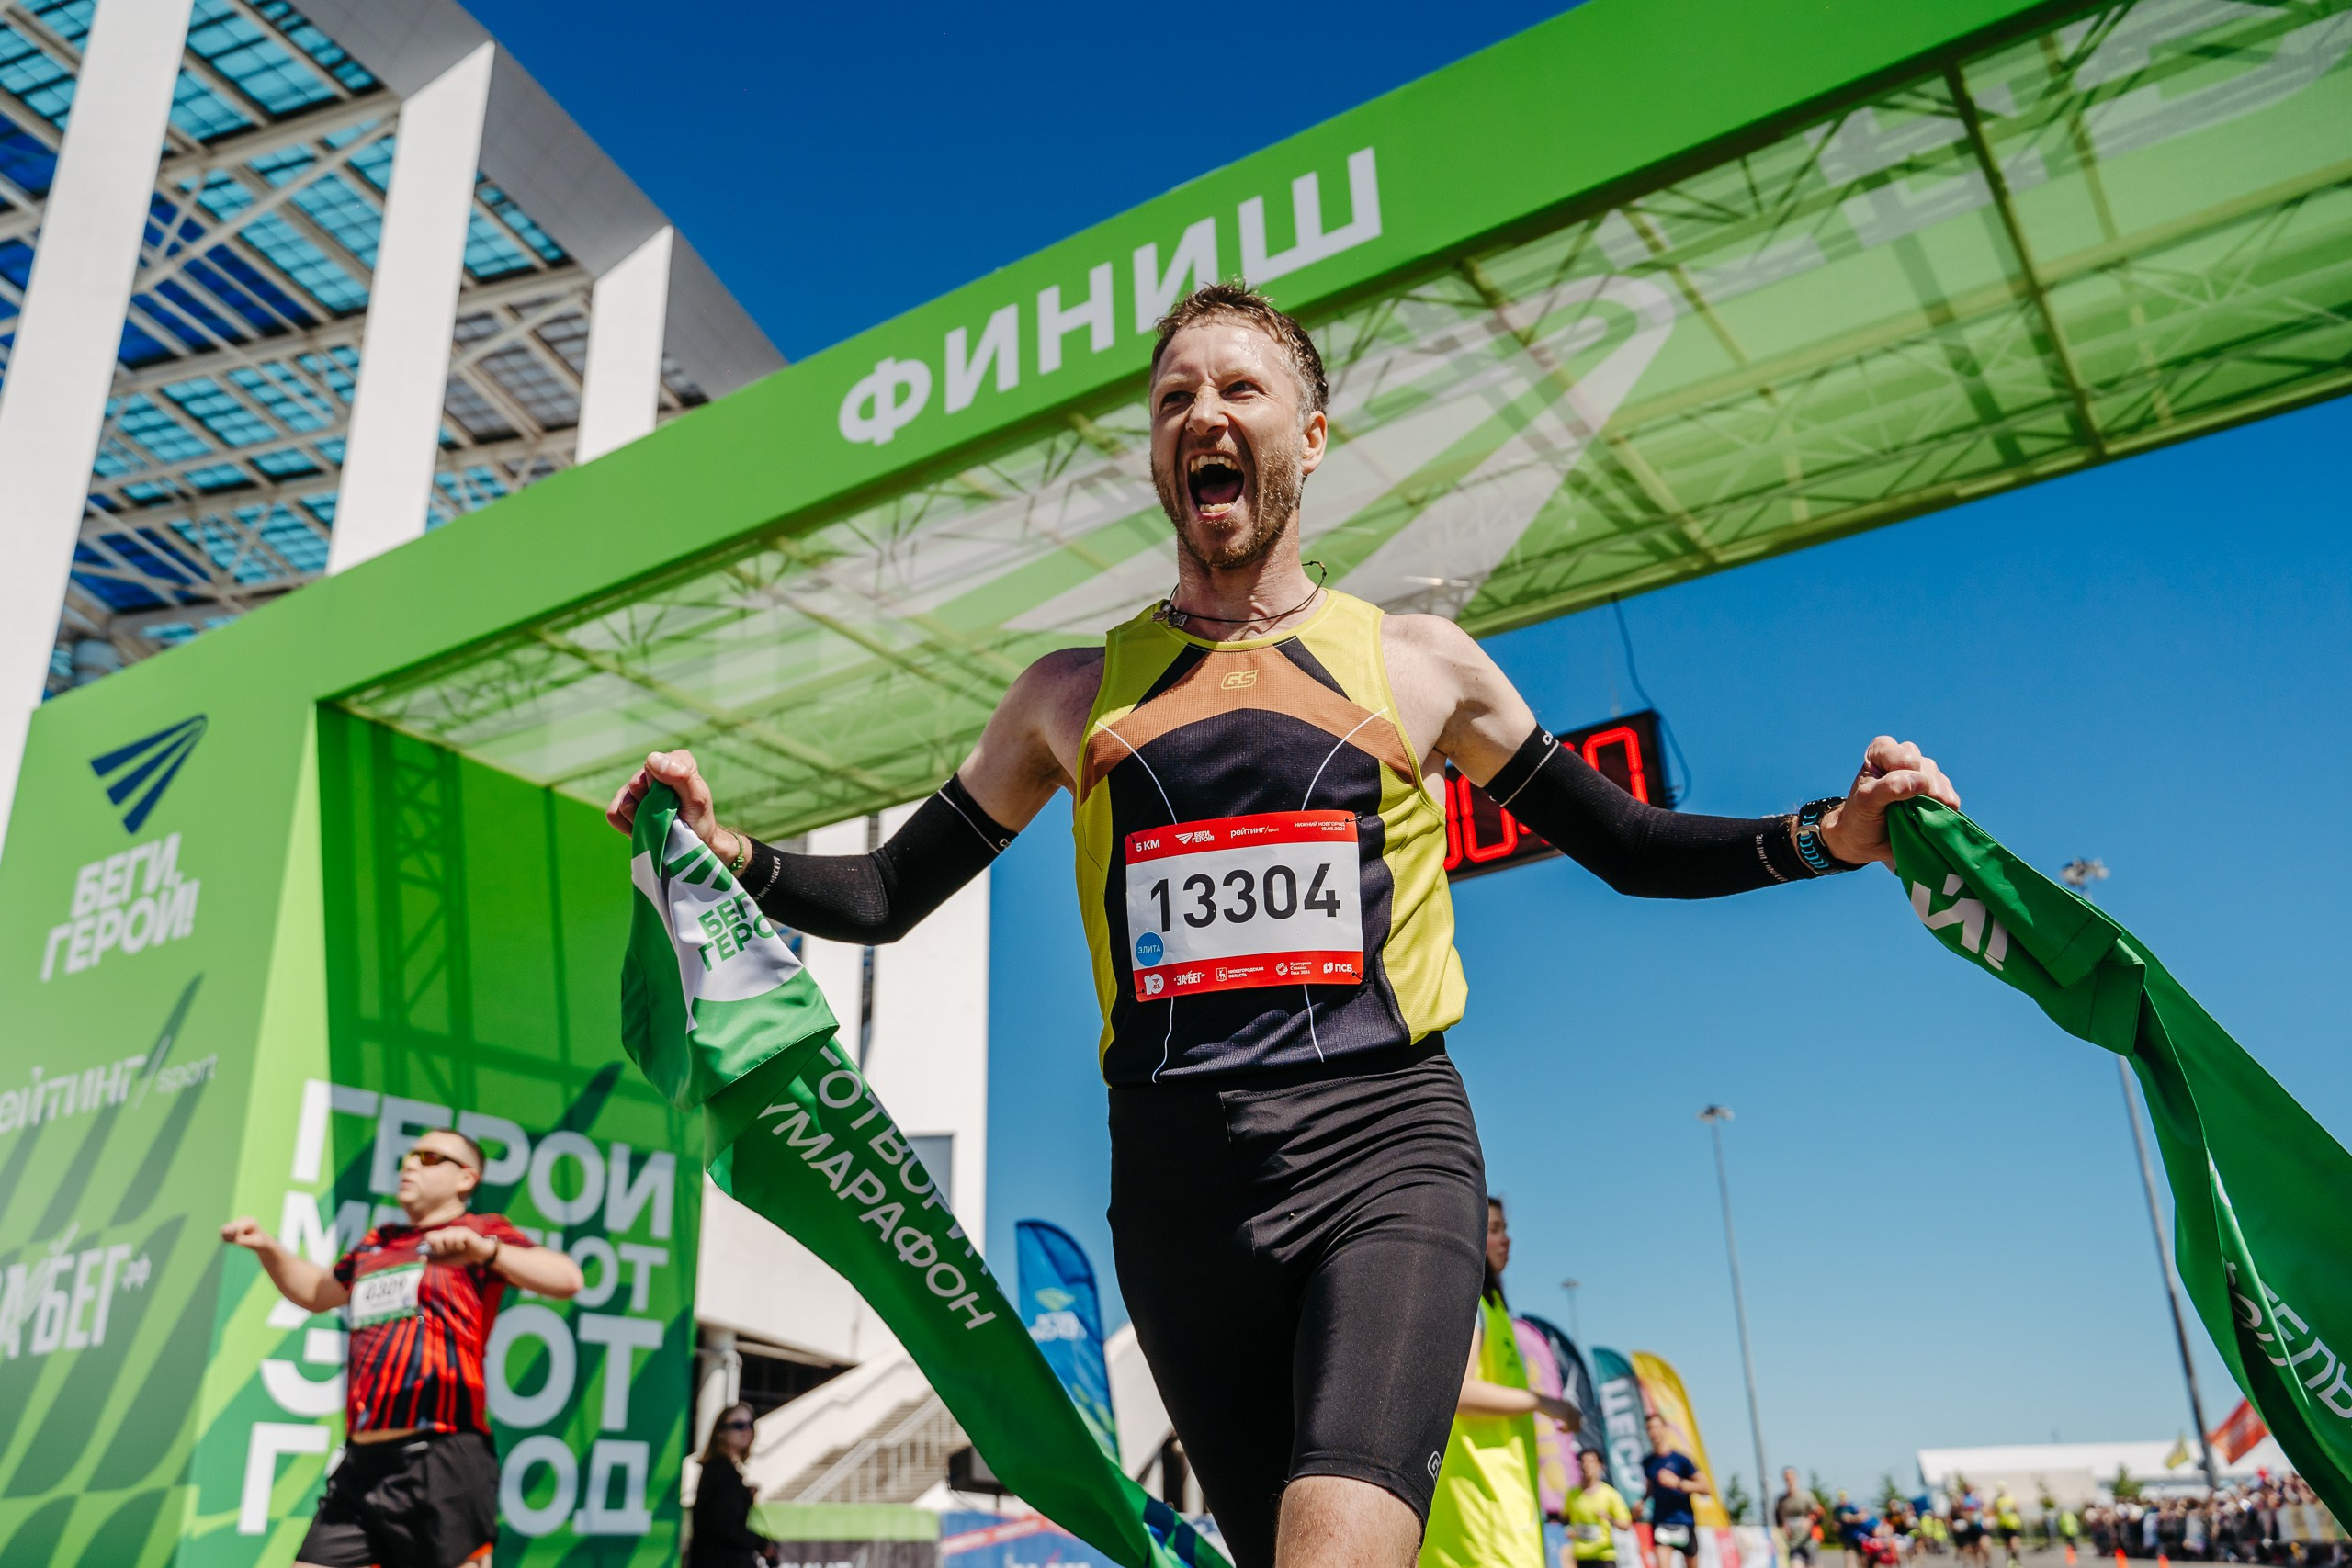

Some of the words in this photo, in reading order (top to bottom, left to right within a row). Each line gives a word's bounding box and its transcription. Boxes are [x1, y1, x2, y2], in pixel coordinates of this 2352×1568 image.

[838, 146, 1383, 446] ФИНИШ
[1136, 842, 1142, 852] 5
[1150, 863, 1341, 932] 13304
[1138, 944, 1161, 954] ЭЛИТА
[1335, 964, 1353, 973] ПСБ
[260, 1303, 663, 1431] ЭОТ
